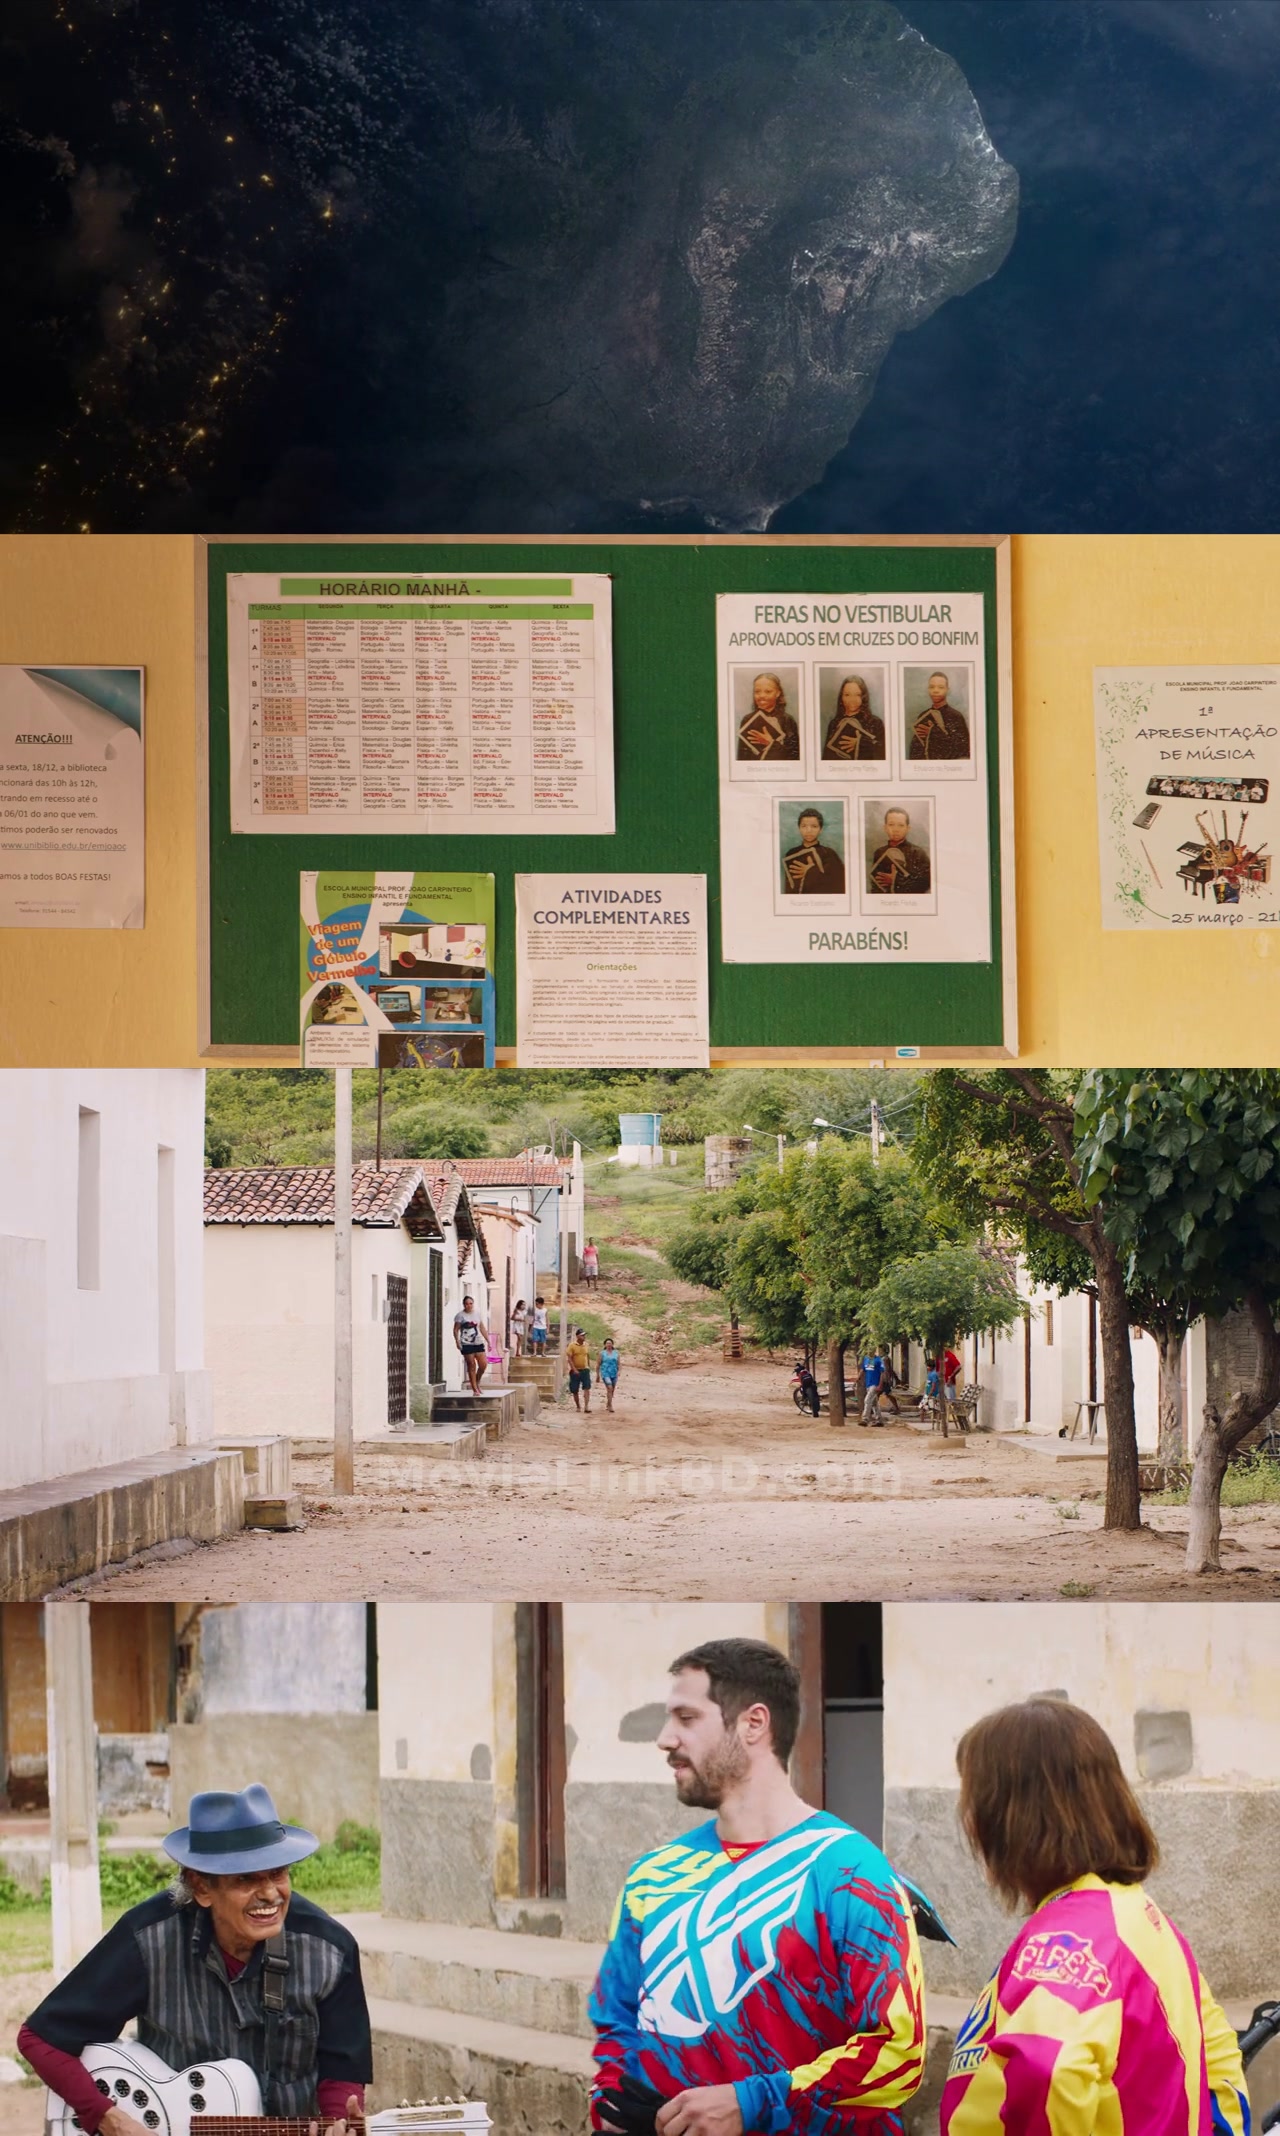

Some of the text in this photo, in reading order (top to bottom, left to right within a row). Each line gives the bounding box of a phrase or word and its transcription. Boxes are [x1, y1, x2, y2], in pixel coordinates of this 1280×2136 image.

[319, 581, 400, 596] HORÁRIO
[407, 580, 470, 596] MANHÃ
[754, 605, 952, 623] FERAS NO VESTIBULAR
[729, 631, 979, 646] APROVADOS EM CRUZES DO BONFIM
[15, 732, 73, 744] ATENÇÃO!!!
[1135, 724, 1278, 741] APRESENTAÇÃO
[1160, 745, 1255, 760] DE MÚSICA
[6, 764, 30, 772] sexta,
[32, 763, 58, 772] 18/12,
[67, 764, 107, 772] biblioteca
[35, 779, 50, 787] das
[52, 779, 67, 787] 10h
[69, 779, 78, 787] às
[80, 780, 98, 788] 12h,
[77, 795, 90, 803] até
[4, 810, 28, 818] 06/01
[30, 810, 41, 818] do
[61, 812, 77, 820] que
[25, 825, 59, 835] poderão
[75, 826, 118, 834] renovados
[30, 873, 53, 881] todos
[55, 873, 77, 881] BOAS
[80, 873, 111, 881] FESTAS!
[561, 890, 662, 904] ATIVIDADES
[533, 911, 690, 925] COMPLEMENTARES
[1171, 914, 1194, 923] 25
[1198, 914, 1243, 926] março
[307, 920, 362, 936] Viagem
[315, 938, 360, 950] de um
[809, 927, 908, 950] PARABÉNS!
[312, 950, 367, 966] Glóbulo
[306, 963, 376, 982] Vermelho
[586, 963, 637, 972] Orientações
